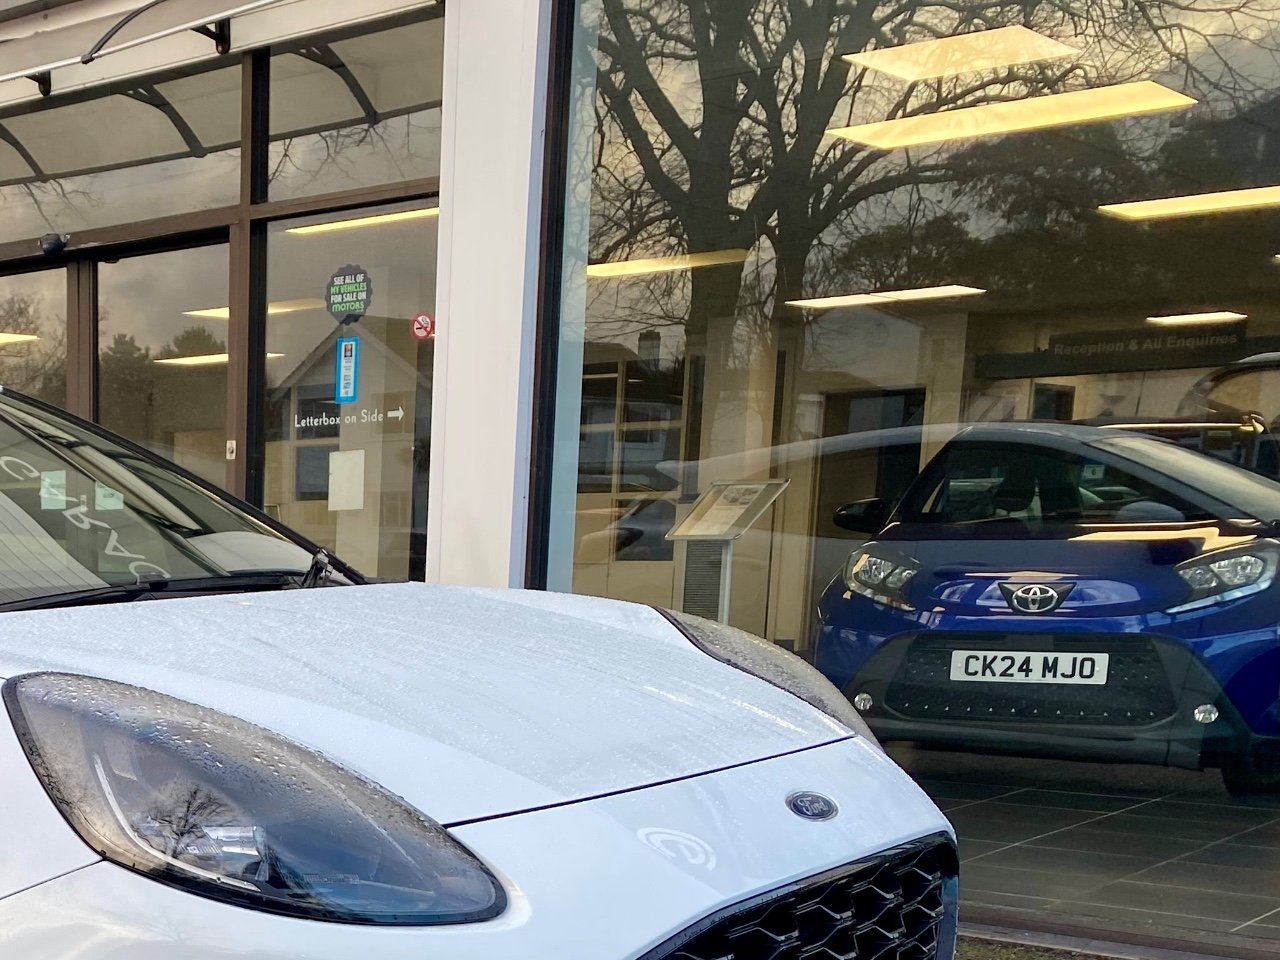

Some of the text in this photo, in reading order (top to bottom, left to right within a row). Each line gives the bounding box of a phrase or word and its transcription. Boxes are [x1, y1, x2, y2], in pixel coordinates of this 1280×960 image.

[333, 273, 365, 286] SEE ALL OF
[330, 282, 367, 295] MY VEHICLES
[330, 291, 367, 304] FOR SALE ON
[331, 301, 365, 312] MOTORS
[1054, 333, 1238, 356] Reception & All Enquiries
[294, 409, 384, 428] Letterbox on Side
[964, 654, 1096, 679] CK24 MJO
[797, 797, 829, 815] Ford
